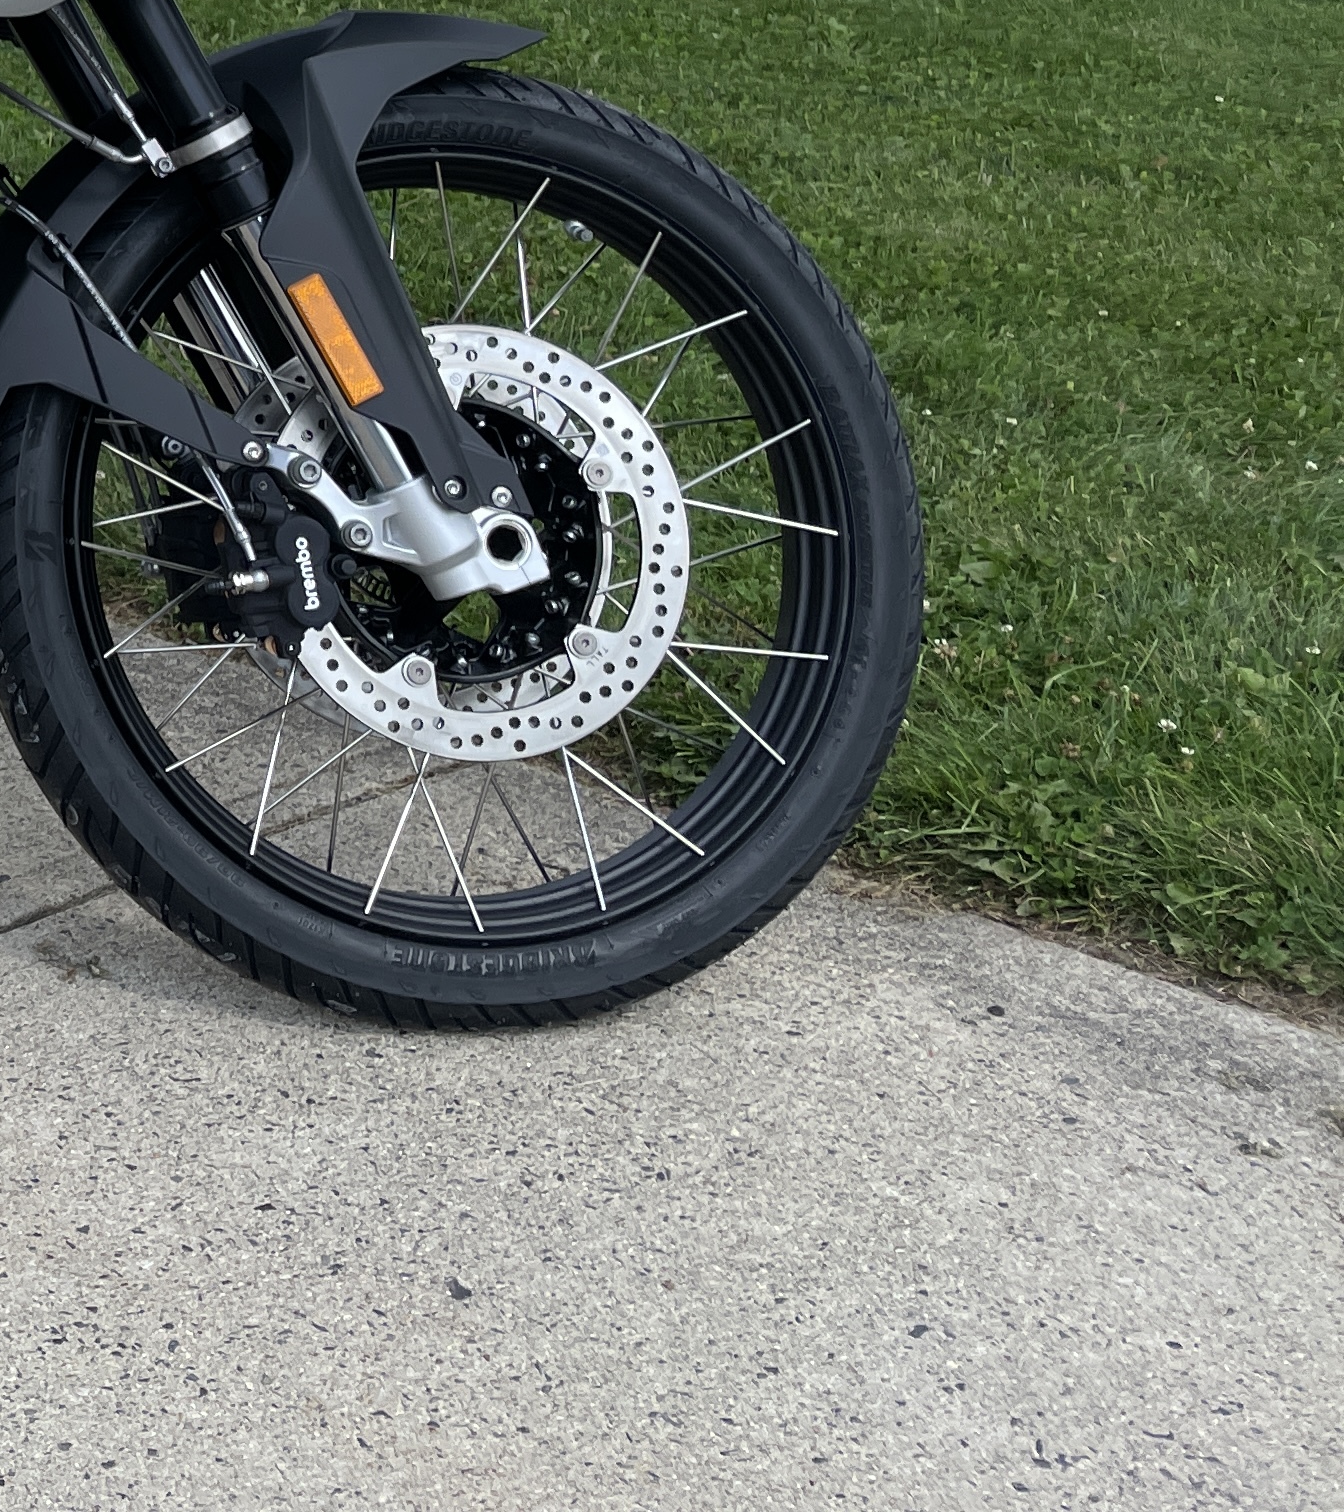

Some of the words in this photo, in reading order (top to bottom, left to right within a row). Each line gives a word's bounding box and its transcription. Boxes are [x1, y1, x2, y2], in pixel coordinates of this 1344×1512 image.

[365, 120, 532, 148] IDGESTONE
[294, 535, 321, 611] brembo
[390, 939, 597, 980] BRIDGESTONE
